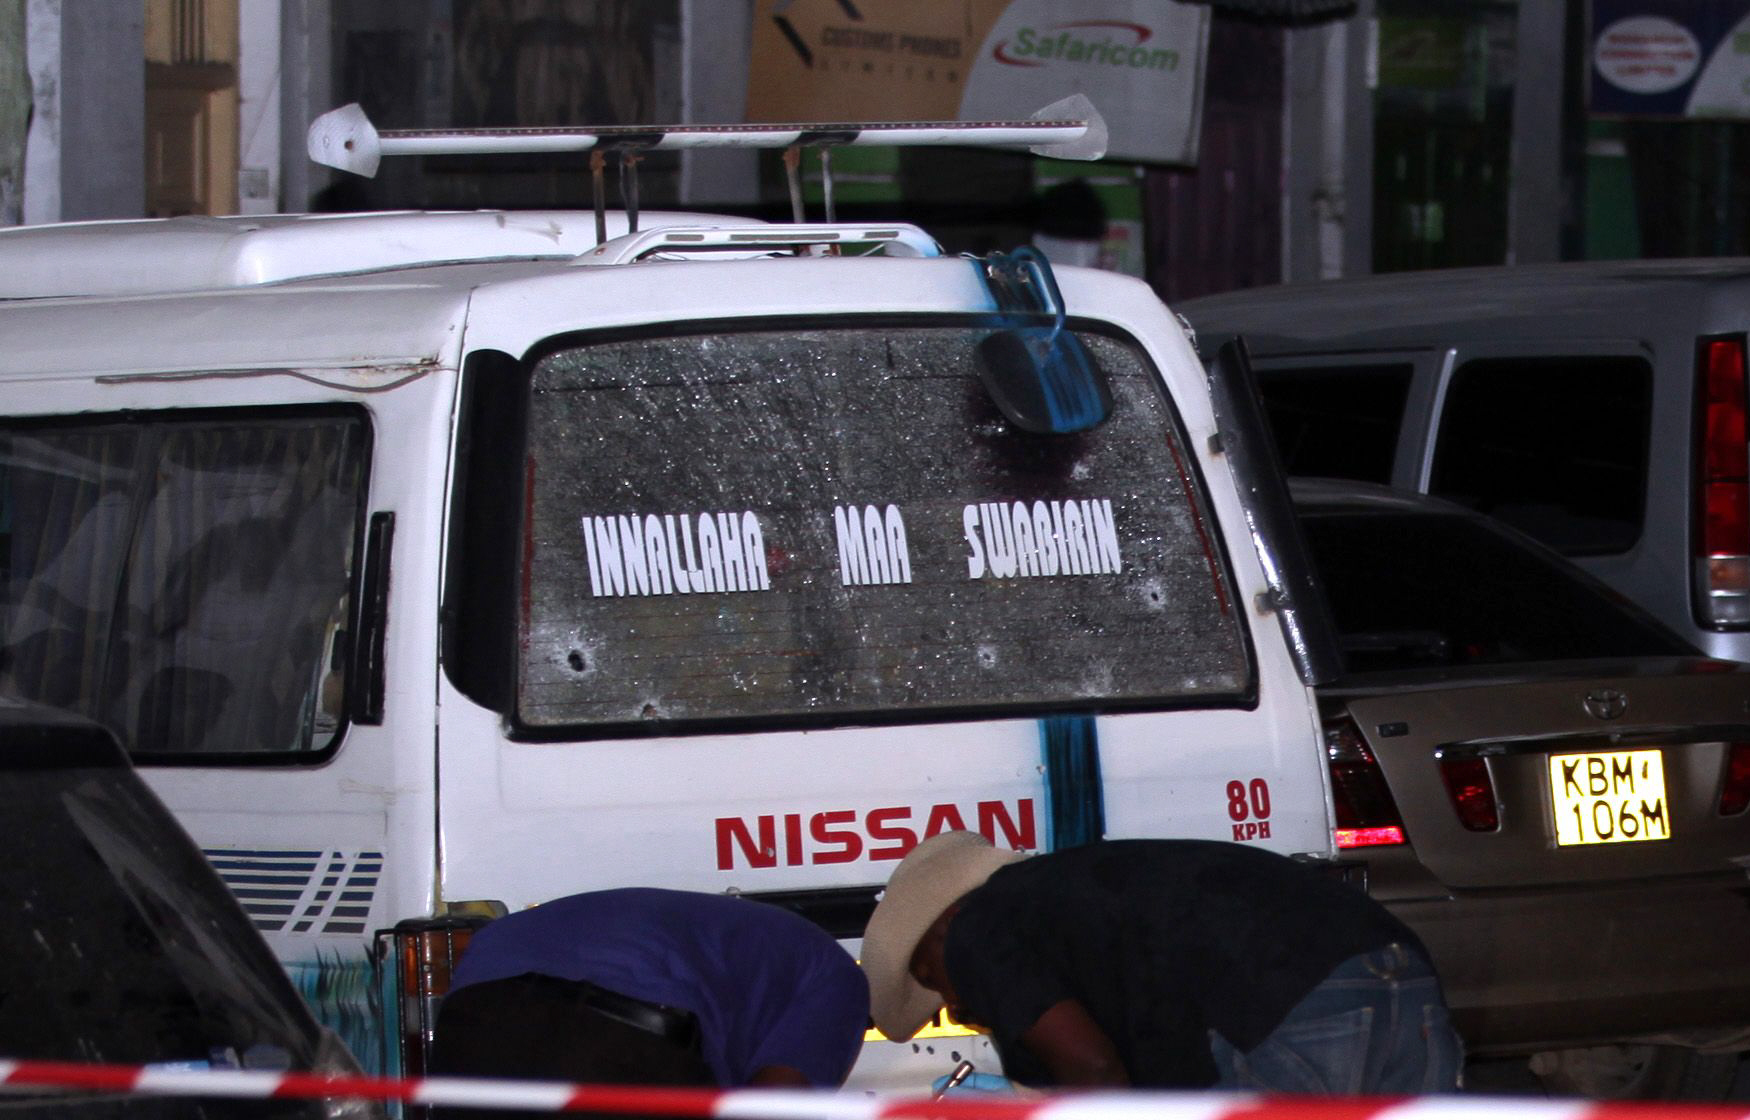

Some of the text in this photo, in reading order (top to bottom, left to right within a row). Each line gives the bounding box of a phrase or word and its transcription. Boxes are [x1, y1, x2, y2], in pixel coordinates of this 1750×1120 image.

[1013, 27, 1179, 70] Safaricom
[582, 499, 1122, 597] INNALLAHA MAA SWABIRIN
[1562, 756, 1635, 798] KBM
[1227, 778, 1271, 822] 80
[1573, 798, 1666, 842] 106M
[715, 798, 1037, 870] NISSAN
[1232, 821, 1271, 841] KPH
